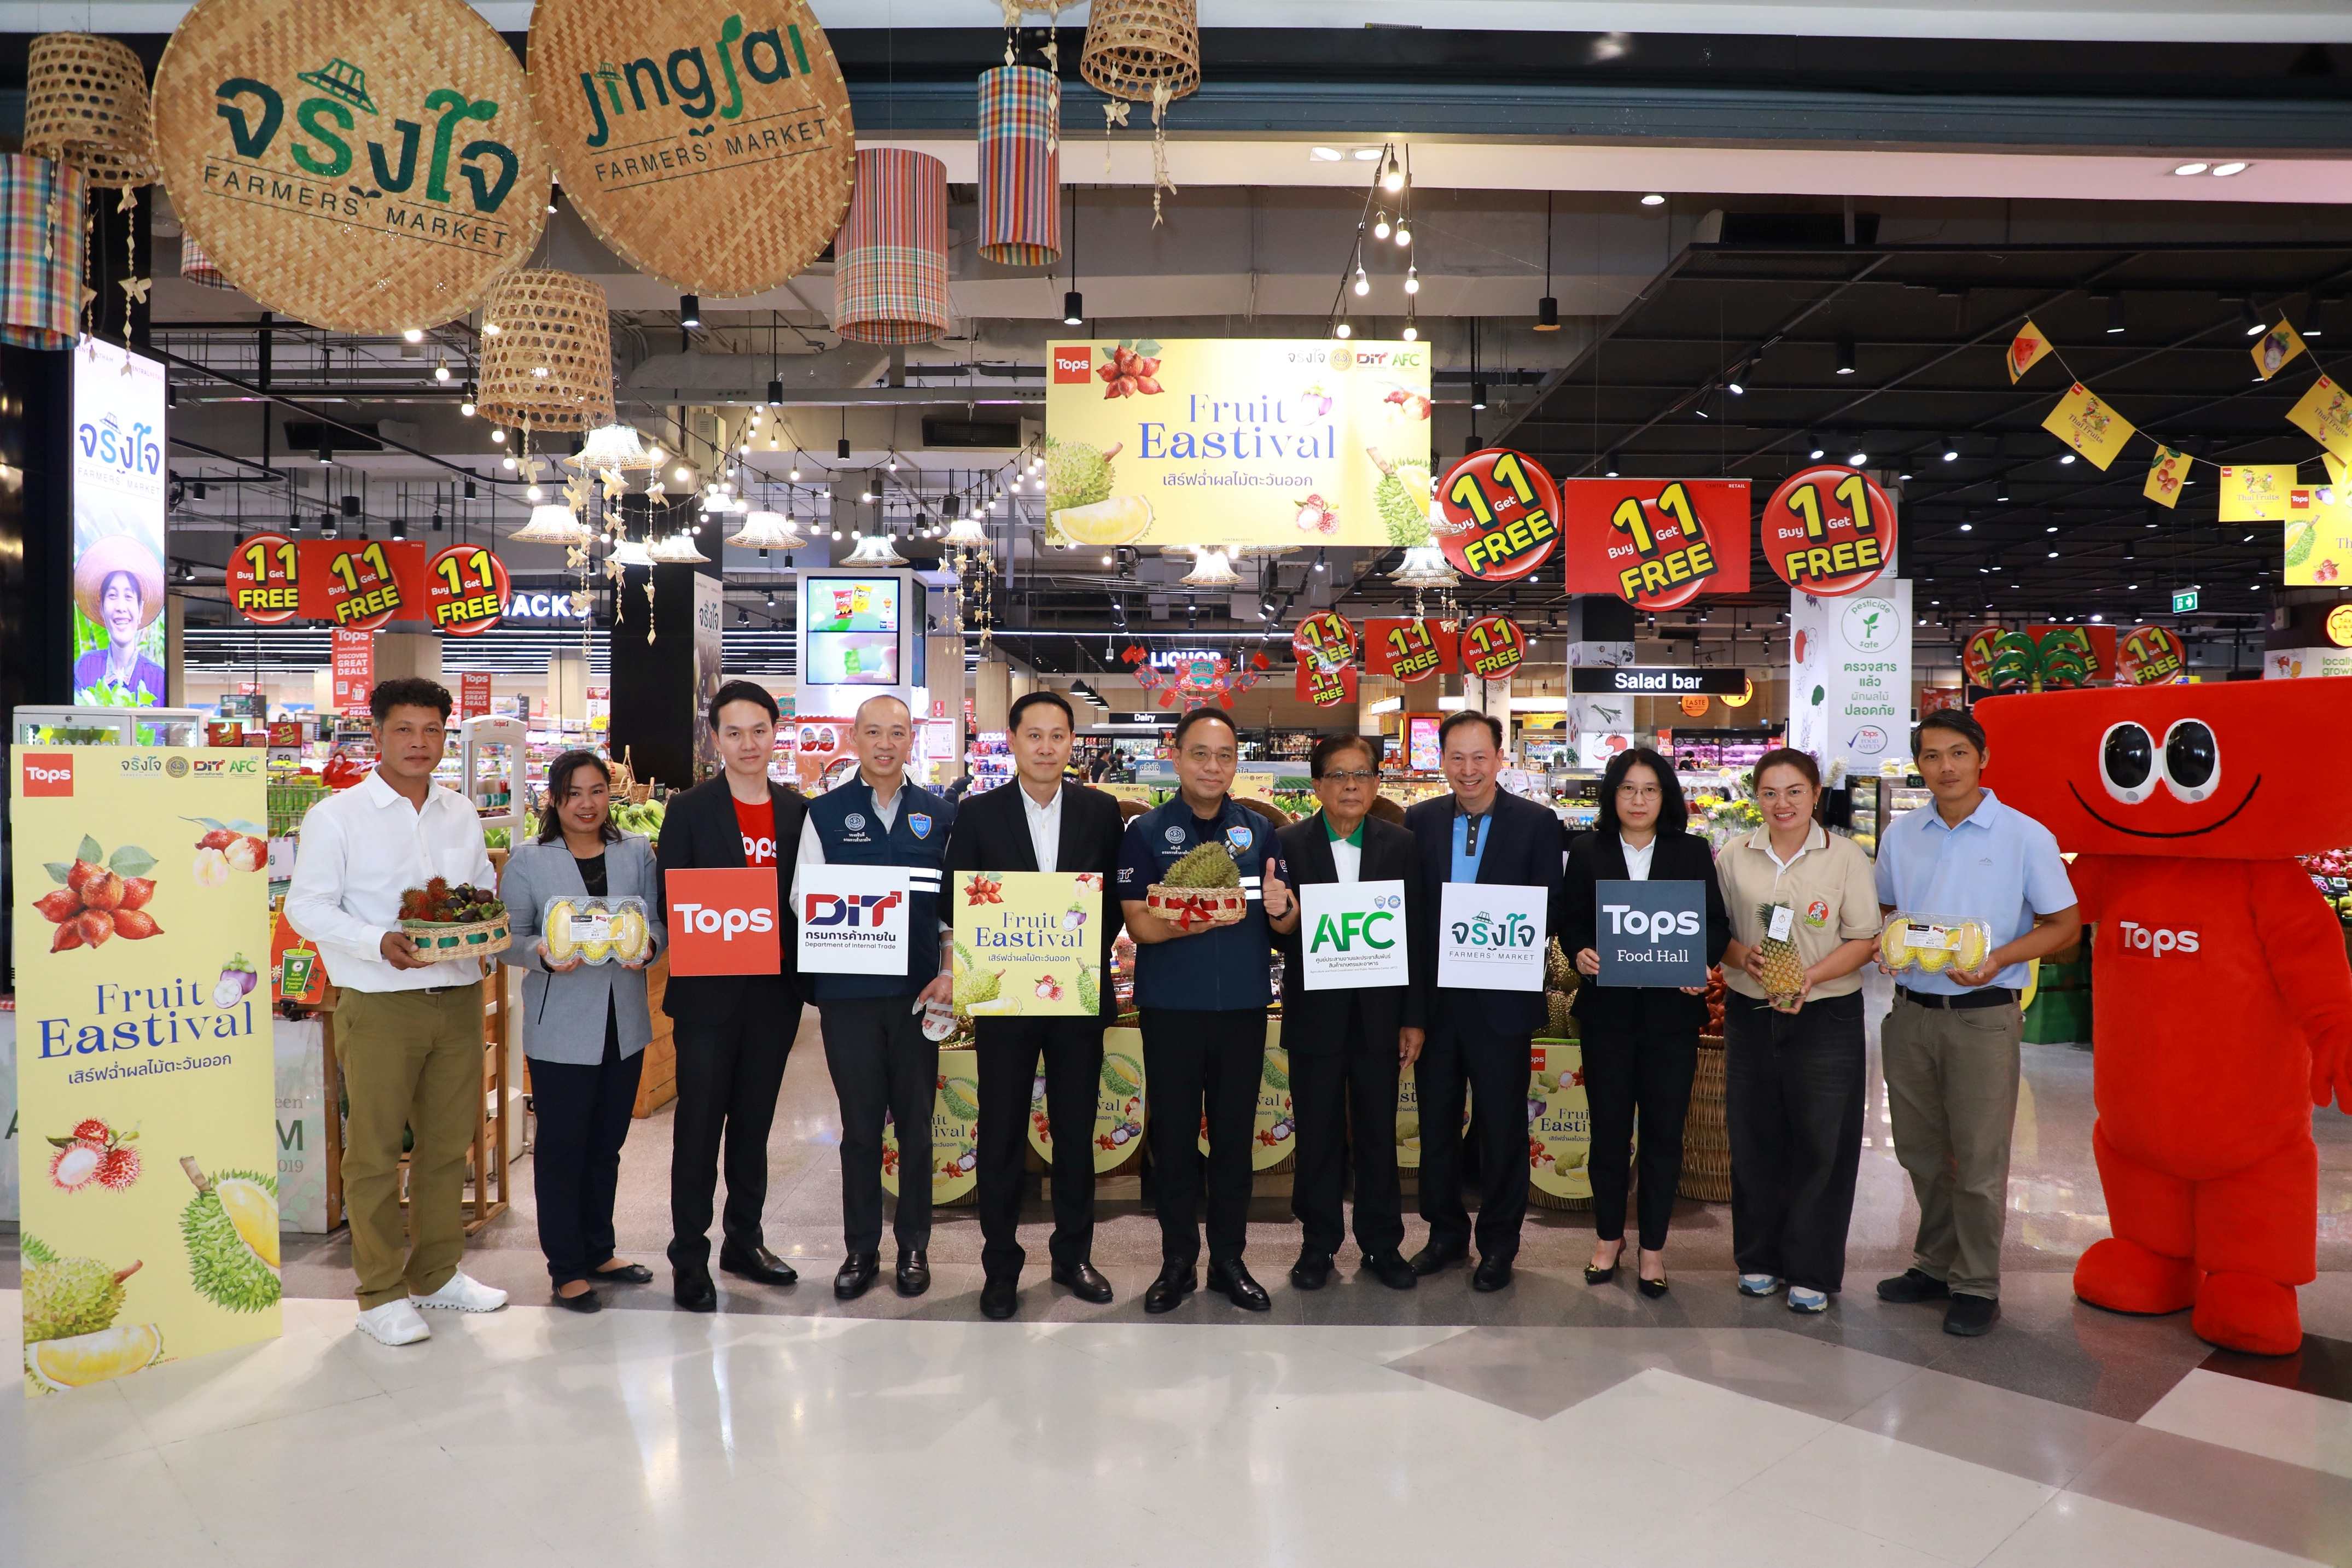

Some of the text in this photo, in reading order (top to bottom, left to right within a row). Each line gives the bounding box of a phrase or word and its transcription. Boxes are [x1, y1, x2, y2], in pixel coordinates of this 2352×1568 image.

[215, 58, 519, 213] จริงใจ
[595, 118, 829, 182] FARMERS' MARKET
[203, 166, 509, 248] FARMERS' MARKET
[1056, 358, 1089, 373] Tops
[1393, 353, 1420, 366] AFC
[1190, 394, 1288, 423] Fruit
[1138, 422, 1335, 459] Eastival
[2068, 413, 2104, 444] Thai Fruits
[79, 412, 160, 475] จริงใจ
[1163, 468, 1313, 487] เสิร์ฟฉ่ำผลไม้ตะวันออก
[1494, 453, 1534, 504] 1
[1451, 475, 1491, 525] 1
[1494, 496, 1516, 512] Get
[1778, 476, 1871, 540] Buy 1 Get 1
[1608, 481, 1697, 558] Buy 1 Get 1
[1463, 510, 1553, 575] FREE
[2337, 538, 2352, 549] Th
[237, 543, 298, 582] Buy 1 Get 1
[329, 543, 389, 596] Buy 1 Get 1
[431, 550, 493, 596] Buy 1 Get 1
[1620, 543, 1713, 600] FREE
[1786, 539, 1881, 582] FREE
[238, 588, 298, 609] FREE
[336, 585, 400, 625] FREE
[436, 594, 499, 627] FREE
[1852, 600, 1890, 614] pesticide
[336, 630, 369, 644] Tops
[1303, 622, 1322, 648] 1
[1326, 614, 1344, 640] 1
[1388, 628, 1408, 655] 1
[1411, 621, 1430, 646] 1
[1471, 627, 1491, 652] 1
[1493, 618, 1512, 644] 1
[1306, 643, 1351, 671] FREE
[1386, 650, 1400, 658] Buy
[2128, 638, 2147, 662] 1
[2150, 628, 2169, 651] 1
[1393, 650, 1439, 678] FREE
[1475, 648, 1521, 674] FREE
[1844, 662, 1897, 672] ตรวจสาร
[2135, 654, 2180, 684] FREE
[2322, 656, 2352, 668] locall
[2322, 668, 2352, 677] grow
[464, 674, 488, 684] Tops
[1615, 673, 1702, 689] Salad bar
[1860, 675, 1881, 686] แล้ว
[1313, 687, 1344, 704] FREE
[1852, 691, 1889, 701] ผักผลไม้
[1134, 714, 1156, 722] Dairy
[1845, 704, 1895, 715] ปลอดภัย
[26, 767, 71, 783] Tops
[121, 756, 161, 771] จริงใจ
[230, 760, 257, 772] AFC
[673, 904, 772, 941] Tops
[1002, 912, 1058, 929] Fruit
[1310, 911, 1396, 953] AFC
[1452, 911, 1535, 948] จริงใจ
[1603, 905, 1700, 943] Tops
[806, 930, 896, 942] กรมการค้าภายใน
[975, 926, 1084, 948] Eastival
[2120, 921, 2199, 958] Tops
[988, 952, 1070, 964] เสิร์ฟฉ่ำผลไม้ตะวันออก
[1617, 949, 1689, 963] Food Hall
[95, 978, 205, 1015] Fruit
[37, 1001, 255, 1059] Eastival
[68, 1053, 232, 1085] เสิร์ฟฉ่ำผลไม้ตะวันออก
[1540, 1118, 1591, 1132] Easti
[1559, 1108, 1588, 1118] Frui
[278, 1160, 303, 1173] 019
